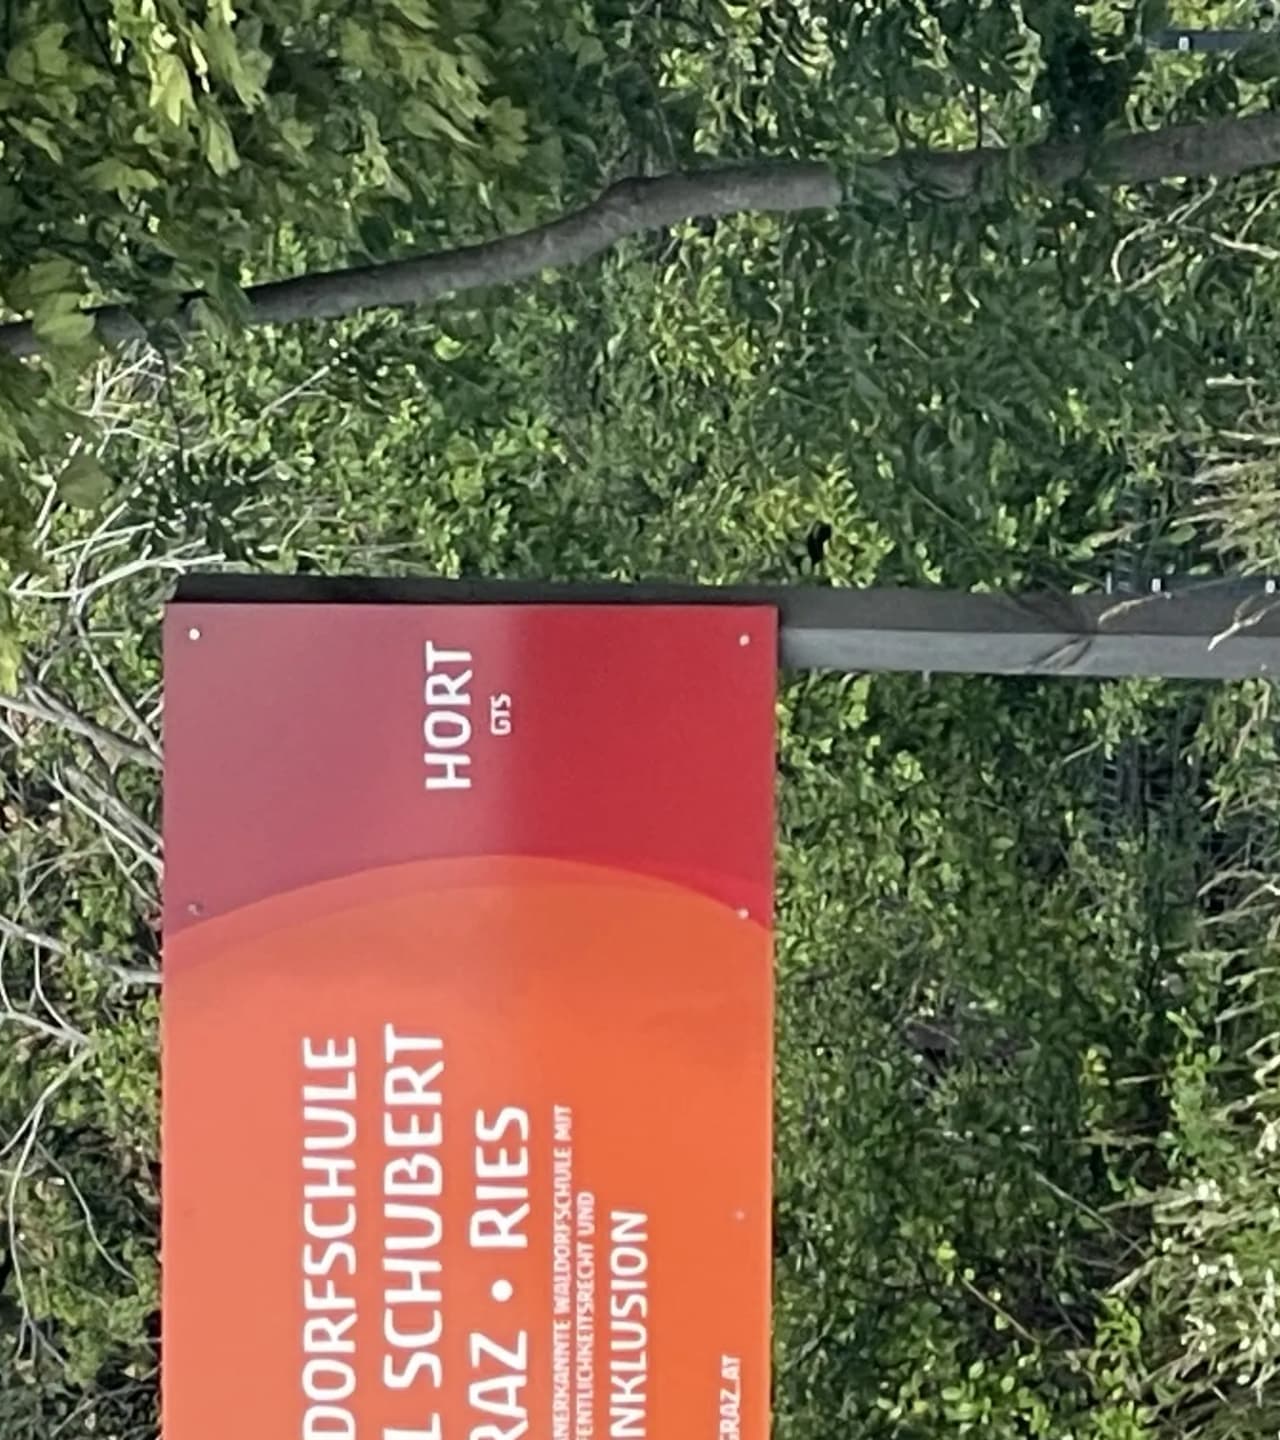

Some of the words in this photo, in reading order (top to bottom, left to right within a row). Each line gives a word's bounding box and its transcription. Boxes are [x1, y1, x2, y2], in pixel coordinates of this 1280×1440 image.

[423, 640, 473, 790] HORT
[489, 693, 512, 736] GTS
[468, 1106, 530, 1249] RIES
[553, 1104, 572, 1143] MIT
[382, 1022, 445, 1390] SCHUBERT
[552, 1148, 573, 1315] WALDORFSCHULE
[575, 1190, 595, 1236] UND
